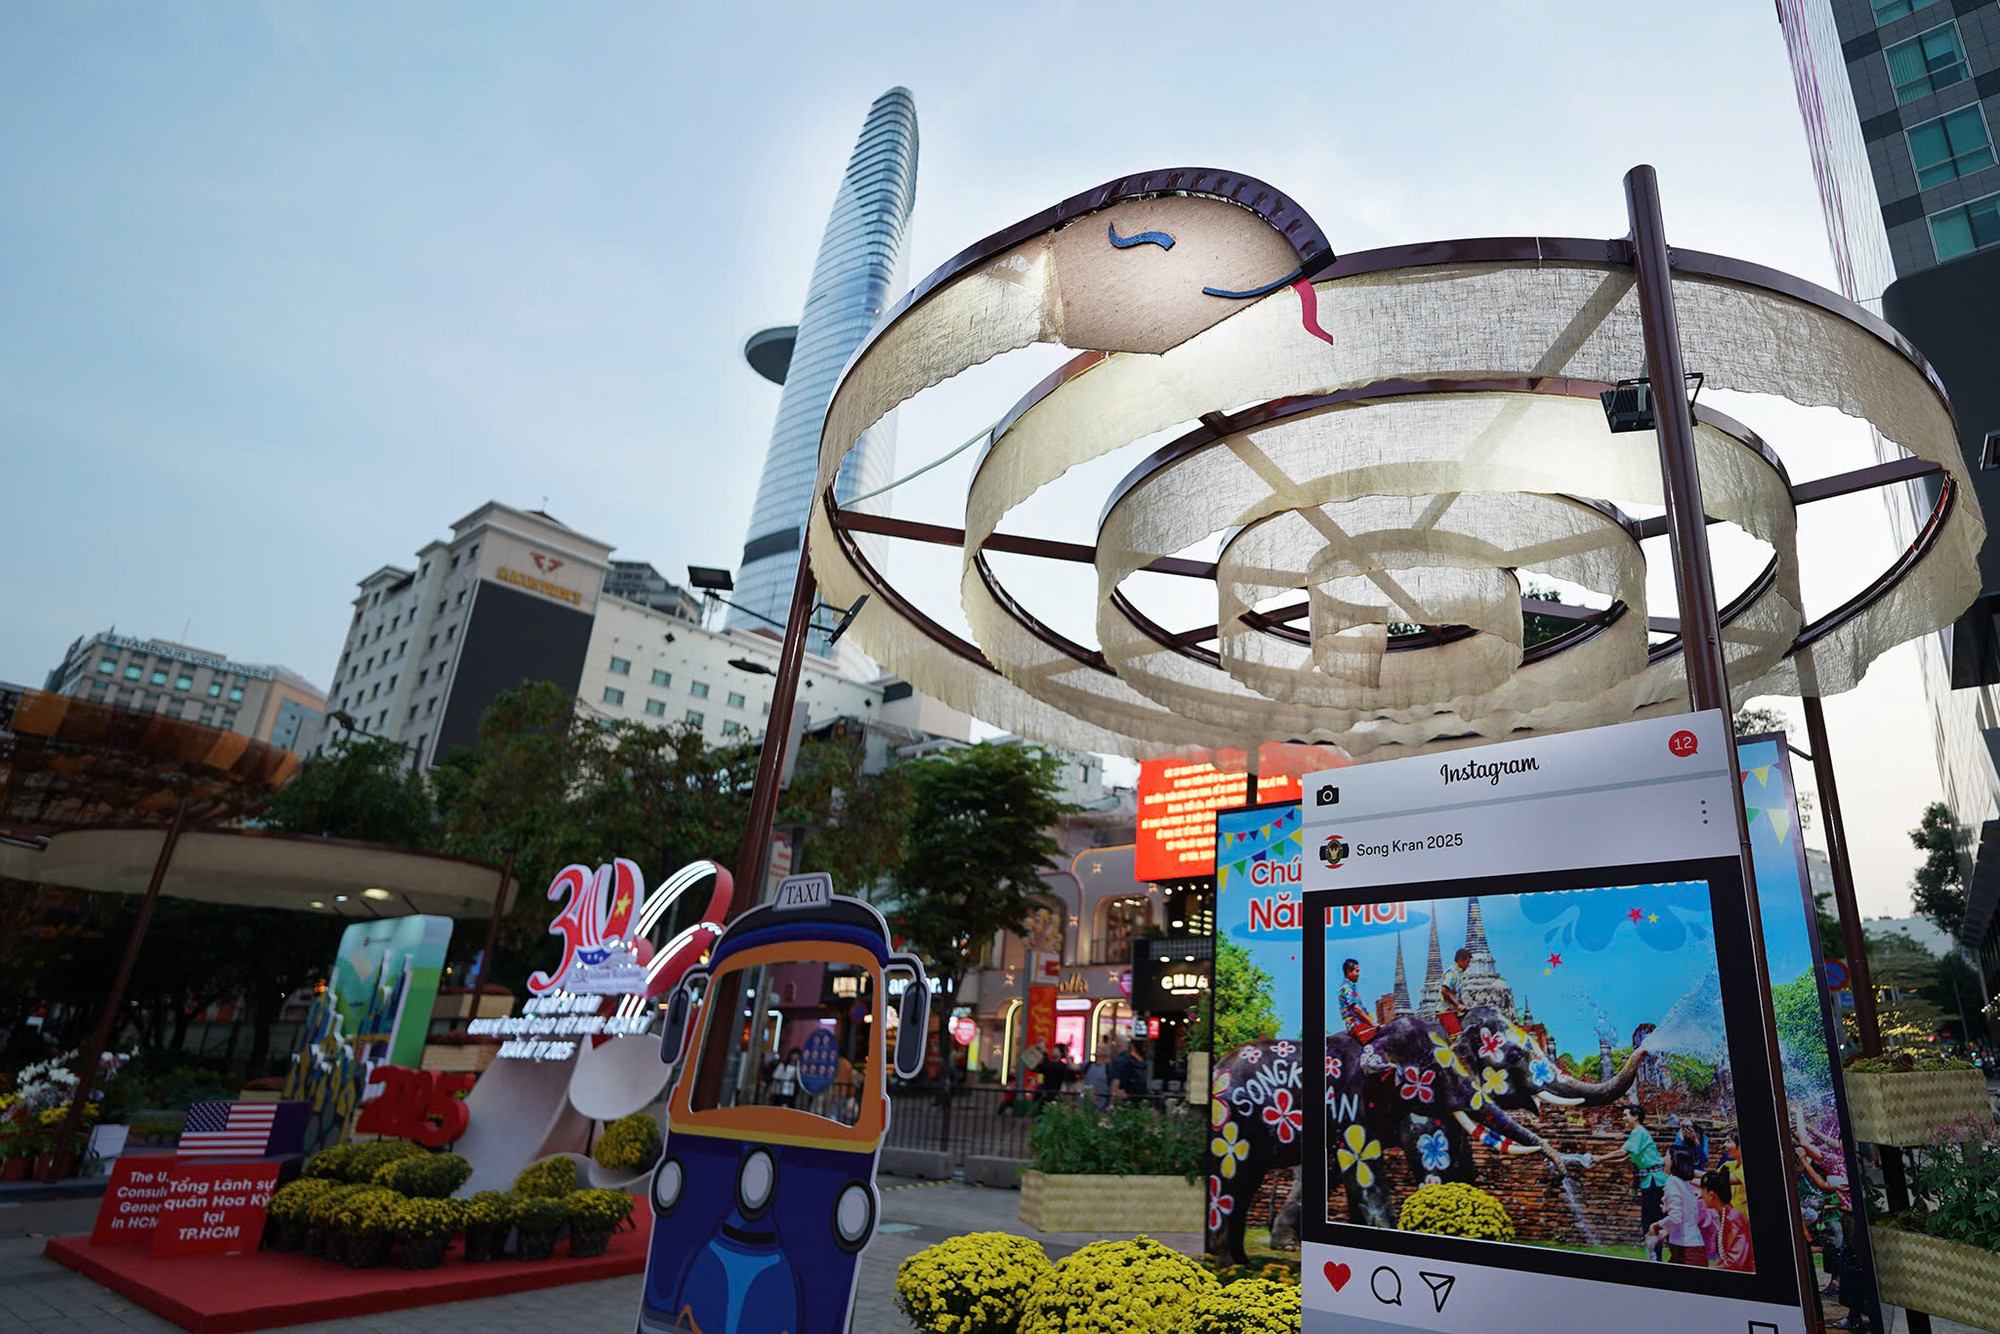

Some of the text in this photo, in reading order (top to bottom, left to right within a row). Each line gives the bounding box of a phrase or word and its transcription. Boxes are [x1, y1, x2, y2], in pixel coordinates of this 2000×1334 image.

[120, 637, 271, 680] HARBOUR VIEW TOWER
[1674, 736, 1693, 750] 12
[1440, 758, 1540, 785] Instagram
[1356, 833, 1463, 857] Song Kran 2025
[1251, 856, 1302, 885] Chú
[786, 882, 821, 905] TAXI
[130, 1171, 154, 1183] The
[213, 1178, 252, 1192] Lãnh
[256, 1179, 277, 1193] sự
[212, 1195, 246, 1208] Hoa
[203, 1211, 225, 1226] tại
